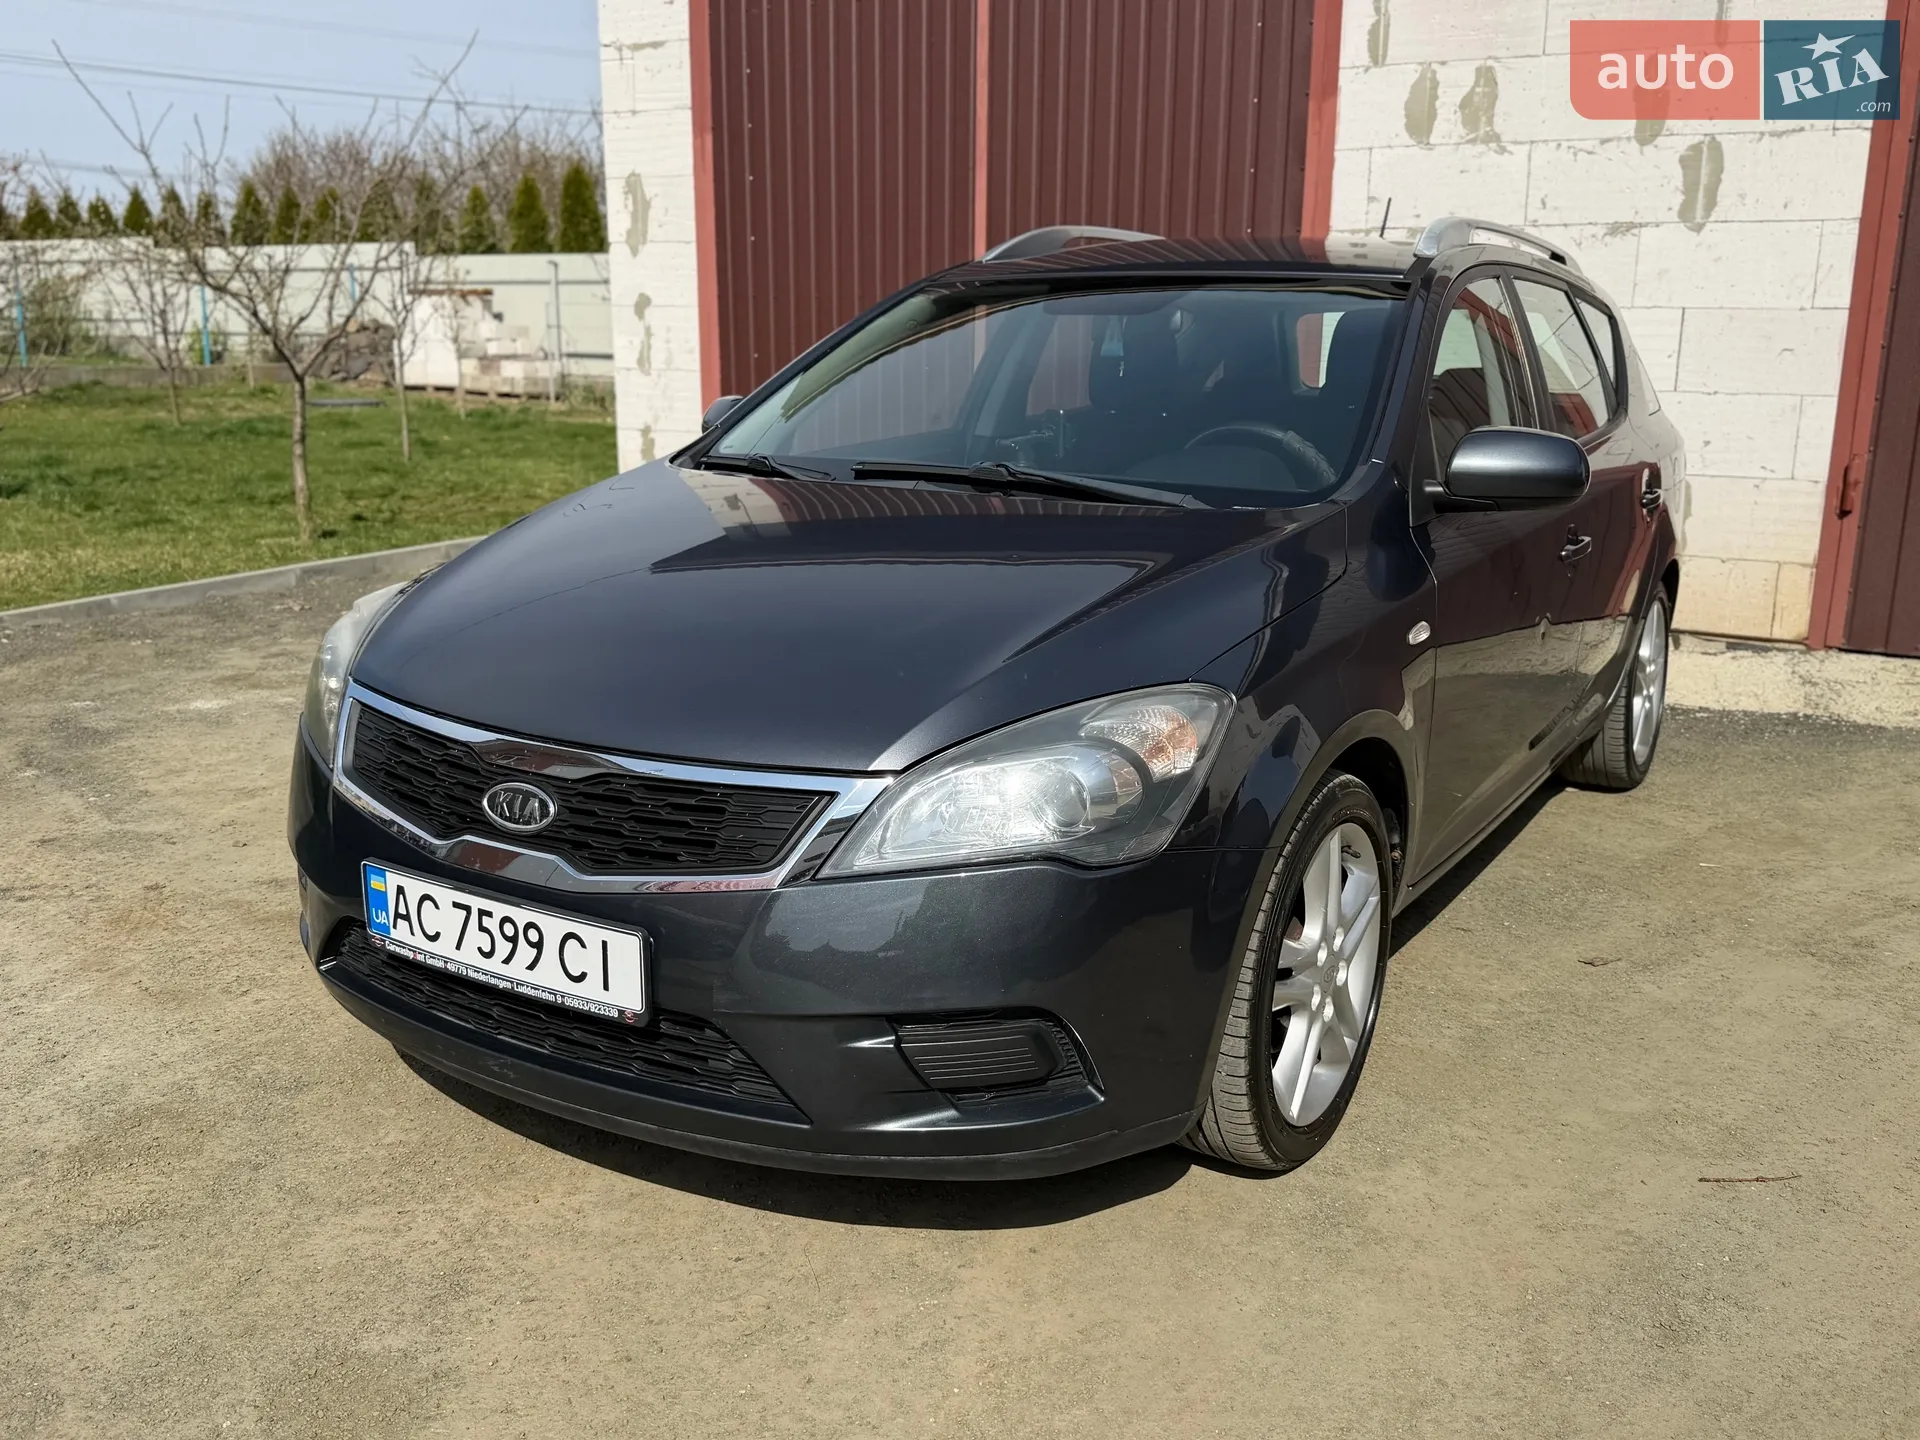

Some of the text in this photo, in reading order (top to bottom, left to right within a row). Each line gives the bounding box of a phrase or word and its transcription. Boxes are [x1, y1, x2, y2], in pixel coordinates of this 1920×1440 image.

[494, 791, 540, 824] KIA
[372, 907, 389, 926] UA
[392, 884, 610, 992] AC 7599 CI
[385, 941, 425, 962] Carwashpoint
[426, 956, 444, 968] GmbH
[446, 961, 467, 975] 49779
[468, 968, 511, 988] Niederlangen
[556, 993, 562, 1003] 9
[565, 996, 618, 1017] 05933/923339
